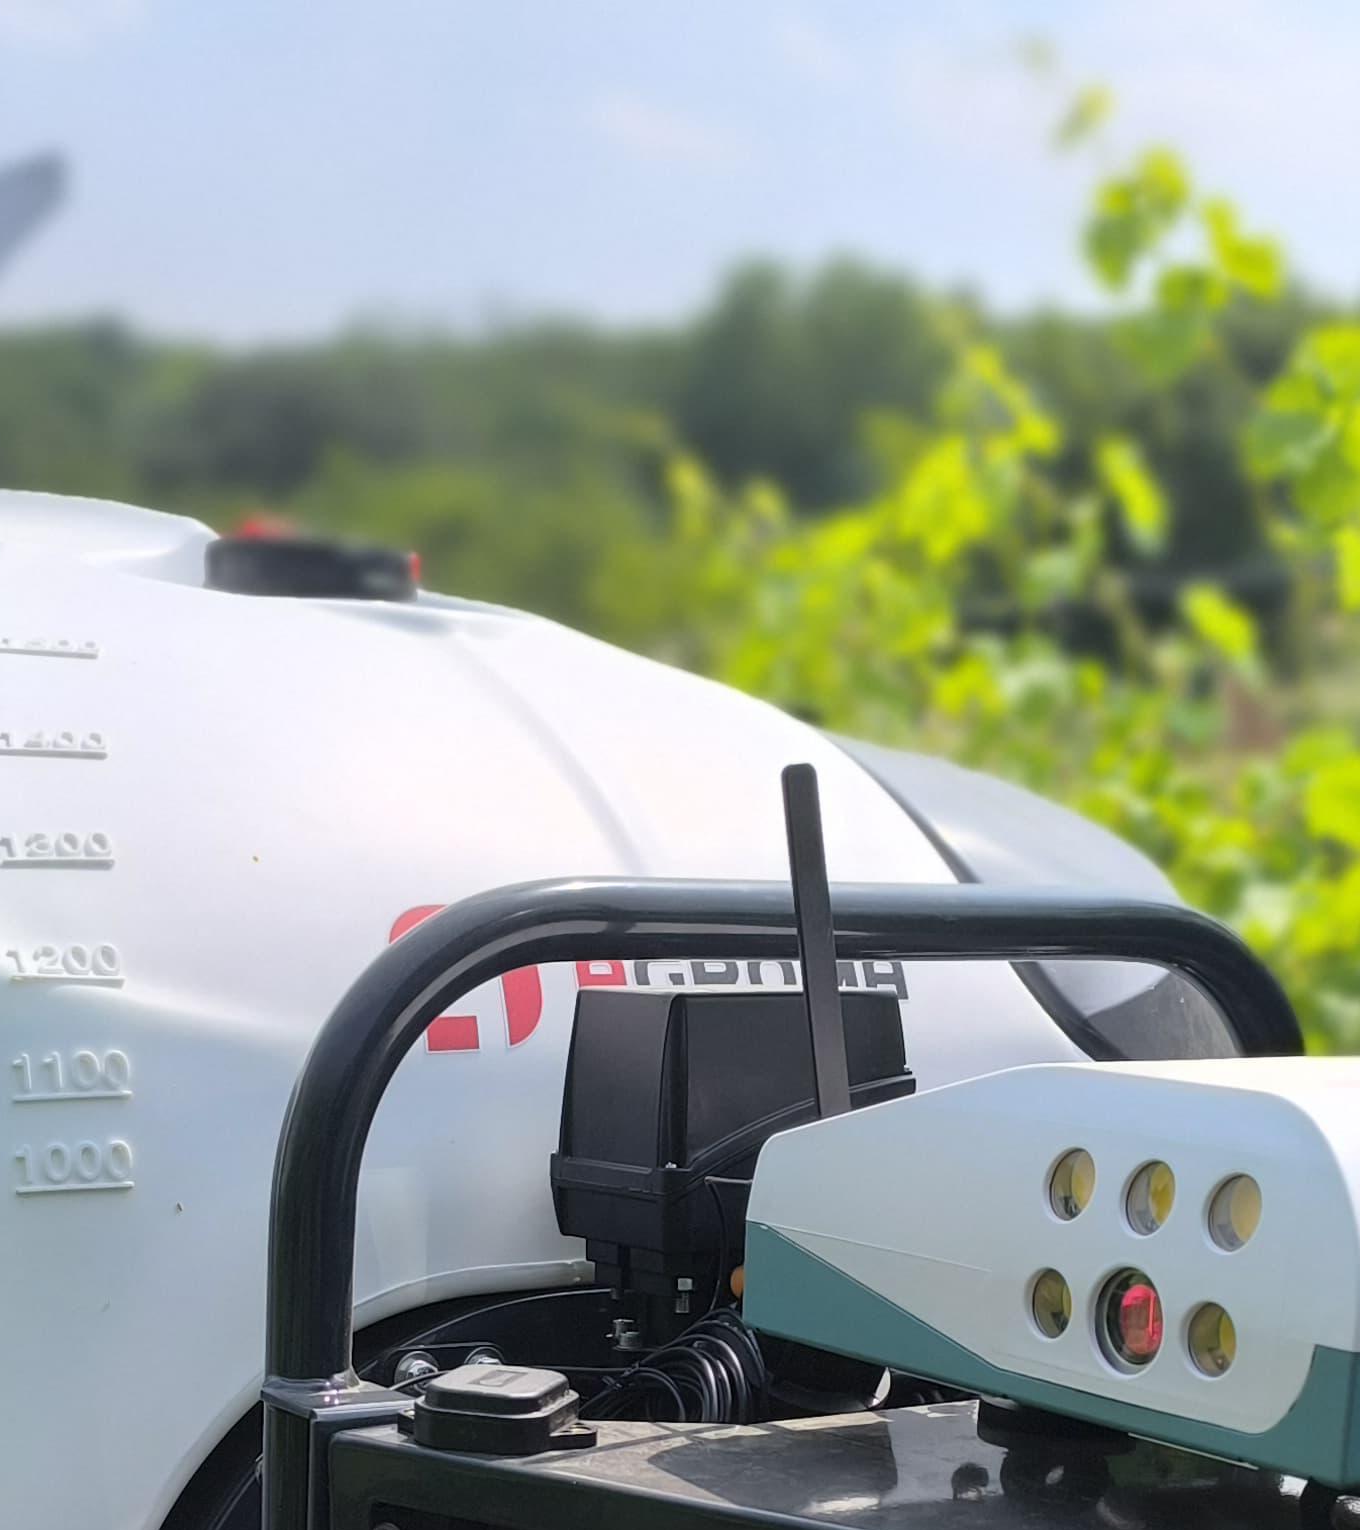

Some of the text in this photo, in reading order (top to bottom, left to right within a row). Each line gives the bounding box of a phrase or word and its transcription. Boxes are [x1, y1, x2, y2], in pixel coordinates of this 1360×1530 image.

[5, 944, 121, 975] 1200
[11, 1049, 131, 1092] 1100
[13, 1140, 134, 1184] 1000
